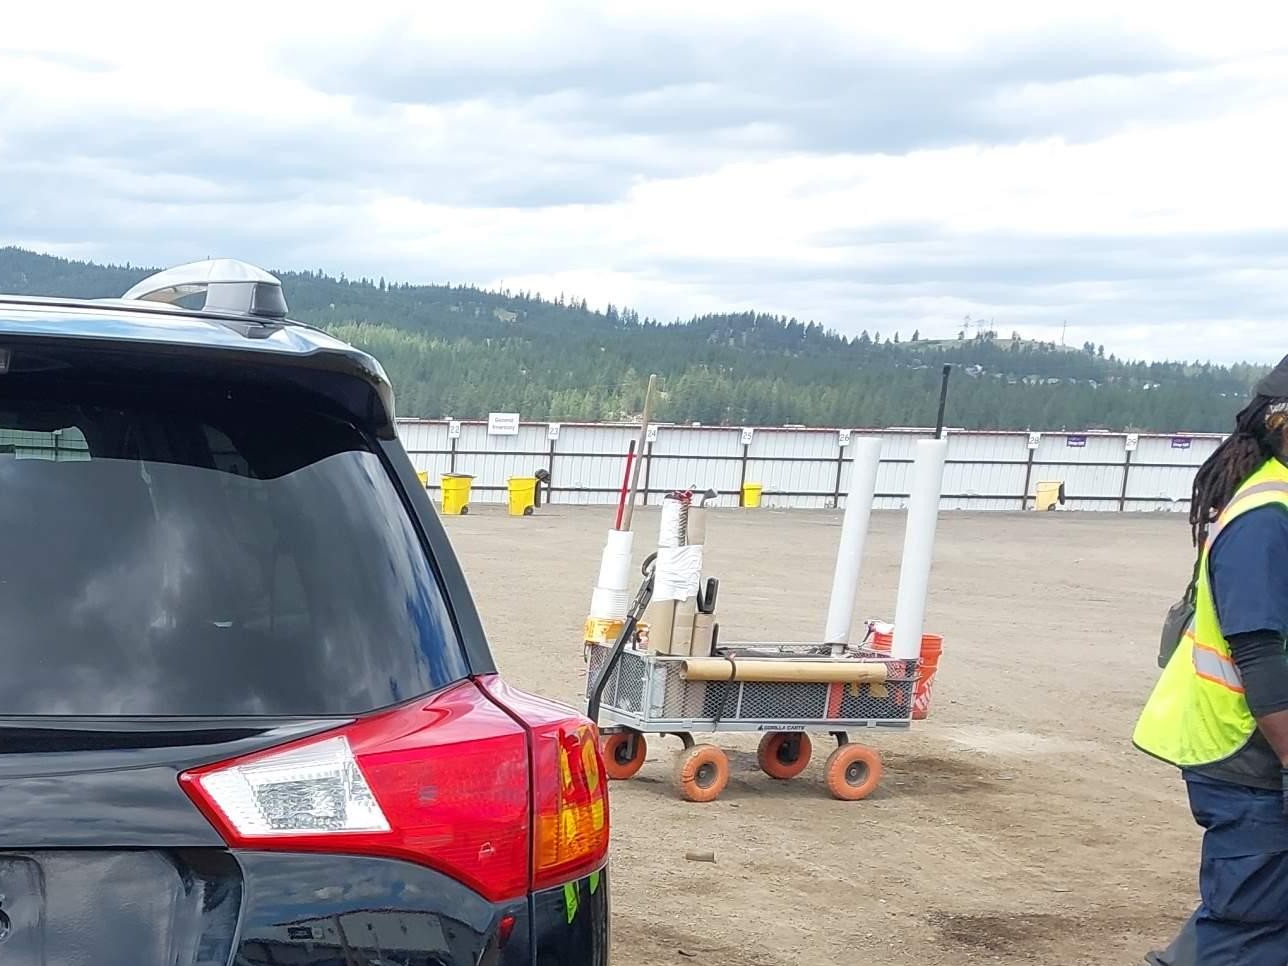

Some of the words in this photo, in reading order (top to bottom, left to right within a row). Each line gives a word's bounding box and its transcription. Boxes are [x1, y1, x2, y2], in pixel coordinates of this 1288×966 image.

[450, 425, 460, 434] 22
[549, 427, 558, 435] 23
[647, 429, 657, 437] 24
[743, 432, 752, 440] 25
[839, 434, 850, 442] 26
